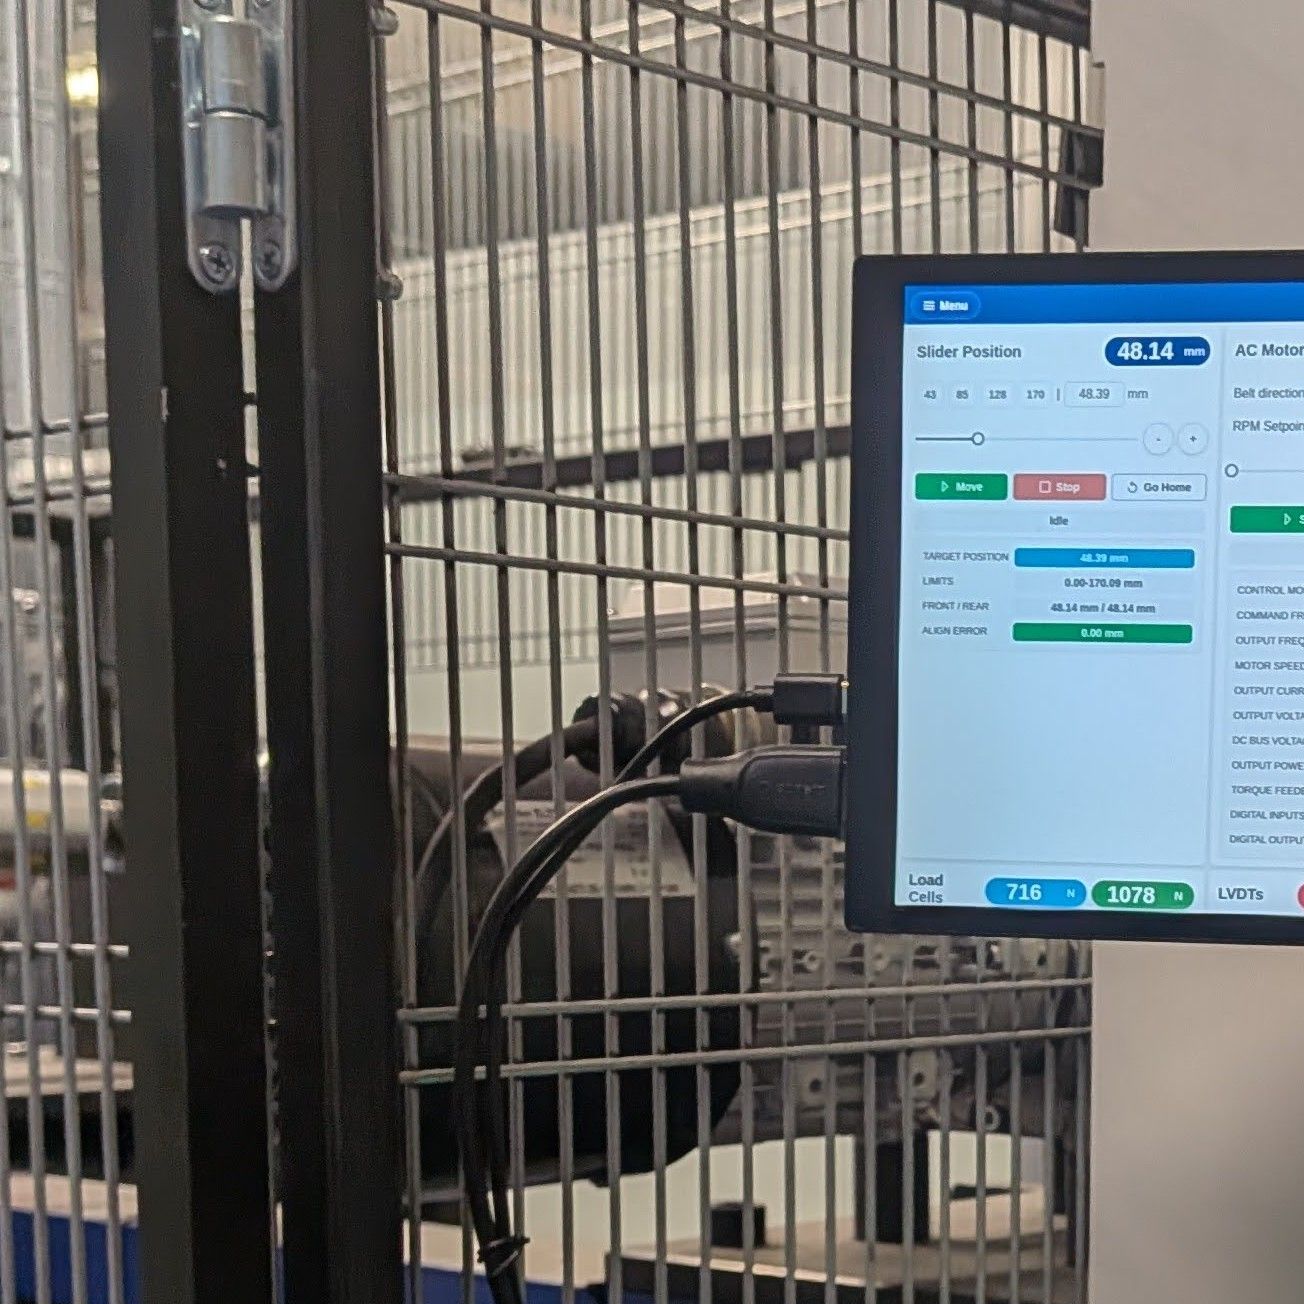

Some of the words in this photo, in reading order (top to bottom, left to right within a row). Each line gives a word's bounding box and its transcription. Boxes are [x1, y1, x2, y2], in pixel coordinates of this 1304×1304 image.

[939, 301, 968, 311] Menu
[917, 346, 958, 358] Slider
[962, 345, 1022, 358] Position
[1118, 342, 1174, 361] 48.14
[1183, 347, 1206, 357] mm
[1235, 345, 1258, 356] AC
[1262, 344, 1304, 356] Motor
[923, 389, 937, 400] 43
[956, 389, 968, 400] 85
[989, 389, 1007, 399] 128
[1027, 389, 1045, 399] 170
[1079, 388, 1110, 400] 48.39
[1128, 390, 1148, 399] mm
[1233, 388, 1254, 399] Belt
[1257, 387, 1304, 398] direction
[1233, 421, 1260, 432] RPM
[956, 482, 983, 492] Move
[1056, 482, 1080, 494] Stop
[1144, 482, 1158, 492] Go
[1162, 482, 1191, 492] Home
[1050, 516, 1068, 526] Idle
[923, 552, 961, 562] TARGET
[963, 552, 1009, 562] POSITION
[1080, 553, 1107, 563] 48.39
[1109, 555, 1128, 563] mm
[922, 577, 953, 586] LIMITS
[1237, 586, 1284, 596] CONTROL
[922, 601, 955, 611] FRONT
[962, 601, 989, 611] REAR
[1051, 603, 1078, 613] 48.14
[1080, 605, 1099, 613] mm
[1107, 603, 1134, 613] 48.14
[1137, 605, 1155, 613] mm
[1237, 611, 1288, 621] COMMAND
[922, 626, 950, 636] ALIGN
[953, 626, 988, 636] ERROR
[1081, 628, 1102, 638] 0.00
[1105, 630, 1124, 638] mm
[1235, 636, 1275, 646] OUTPUT
[1235, 661, 1271, 671] MOTOR
[1234, 686, 1274, 696] OUTPUT
[1233, 711, 1273, 721] OUTPUT
[1233, 736, 1247, 745] DC
[1249, 736, 1270, 746] BUS
[1231, 761, 1271, 771] OUTPUT
[1232, 786, 1272, 796] TORQUE
[1230, 810, 1267, 820] DIGITAL
[1269, 811, 1304, 820] INPUTS
[1229, 835, 1266, 844] DIGITAL
[908, 874, 943, 886] Load
[908, 891, 943, 903] Cells
[1006, 884, 1042, 900] 716
[1067, 889, 1075, 897] N
[1108, 886, 1155, 903] 1078
[1174, 891, 1183, 900] N
[1218, 888, 1264, 900] LVDTs
